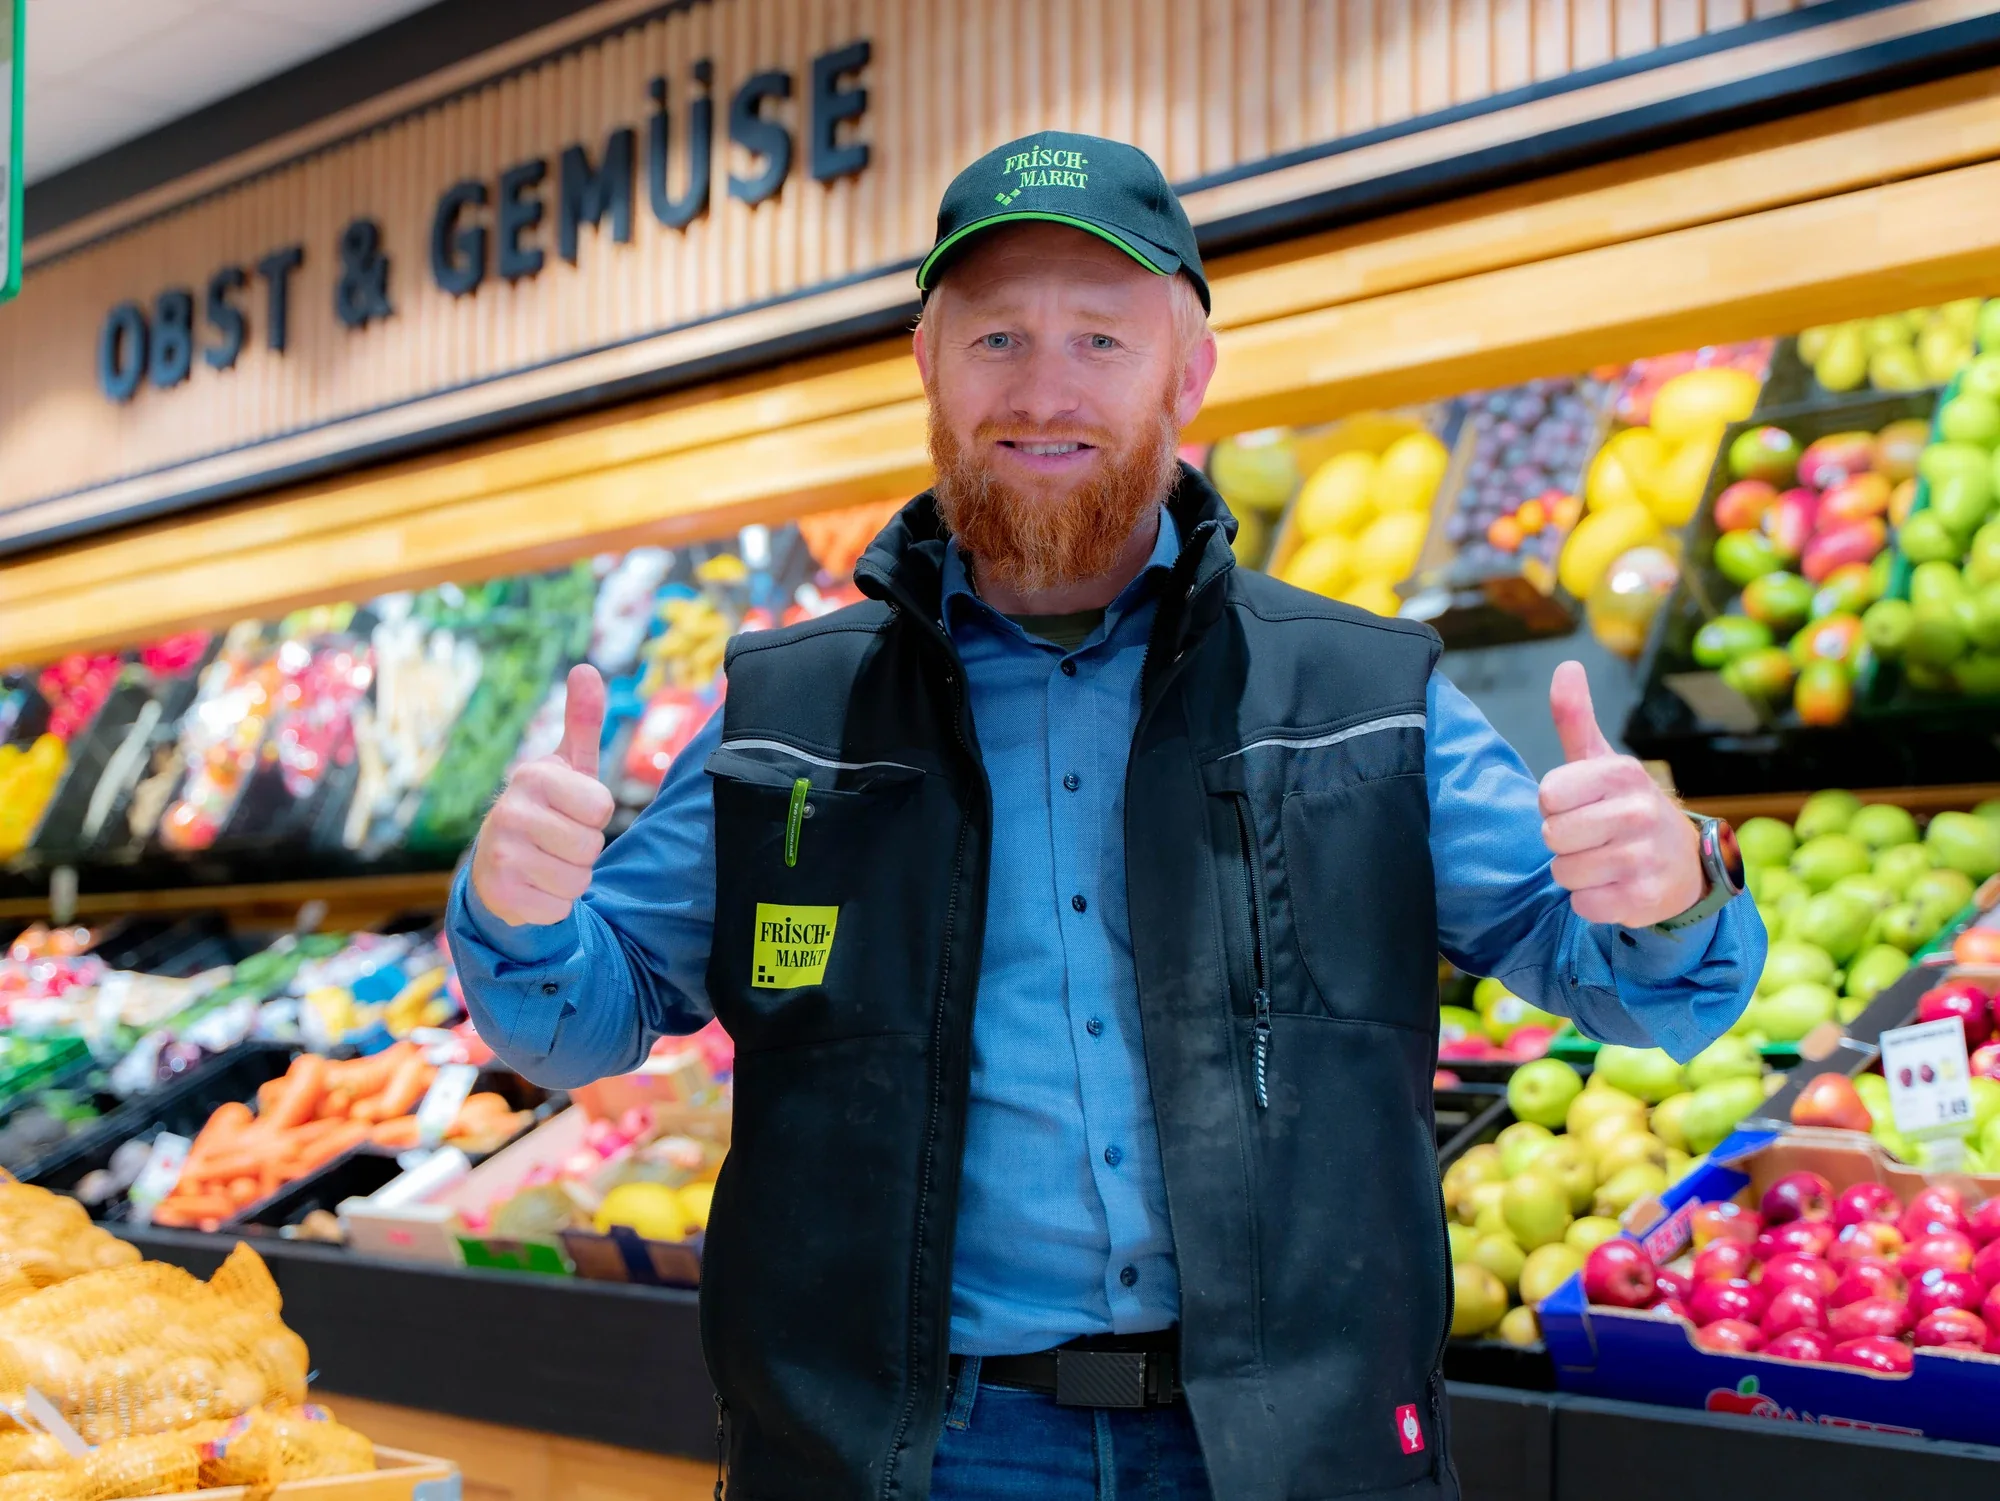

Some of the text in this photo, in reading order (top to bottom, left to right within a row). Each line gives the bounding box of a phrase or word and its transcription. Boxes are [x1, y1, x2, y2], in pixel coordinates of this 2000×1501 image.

[1019, 170, 1088, 189] MARKT
[98, 40, 872, 403] OBST & GEMÜSE
[775, 949, 826, 967] MARKT
